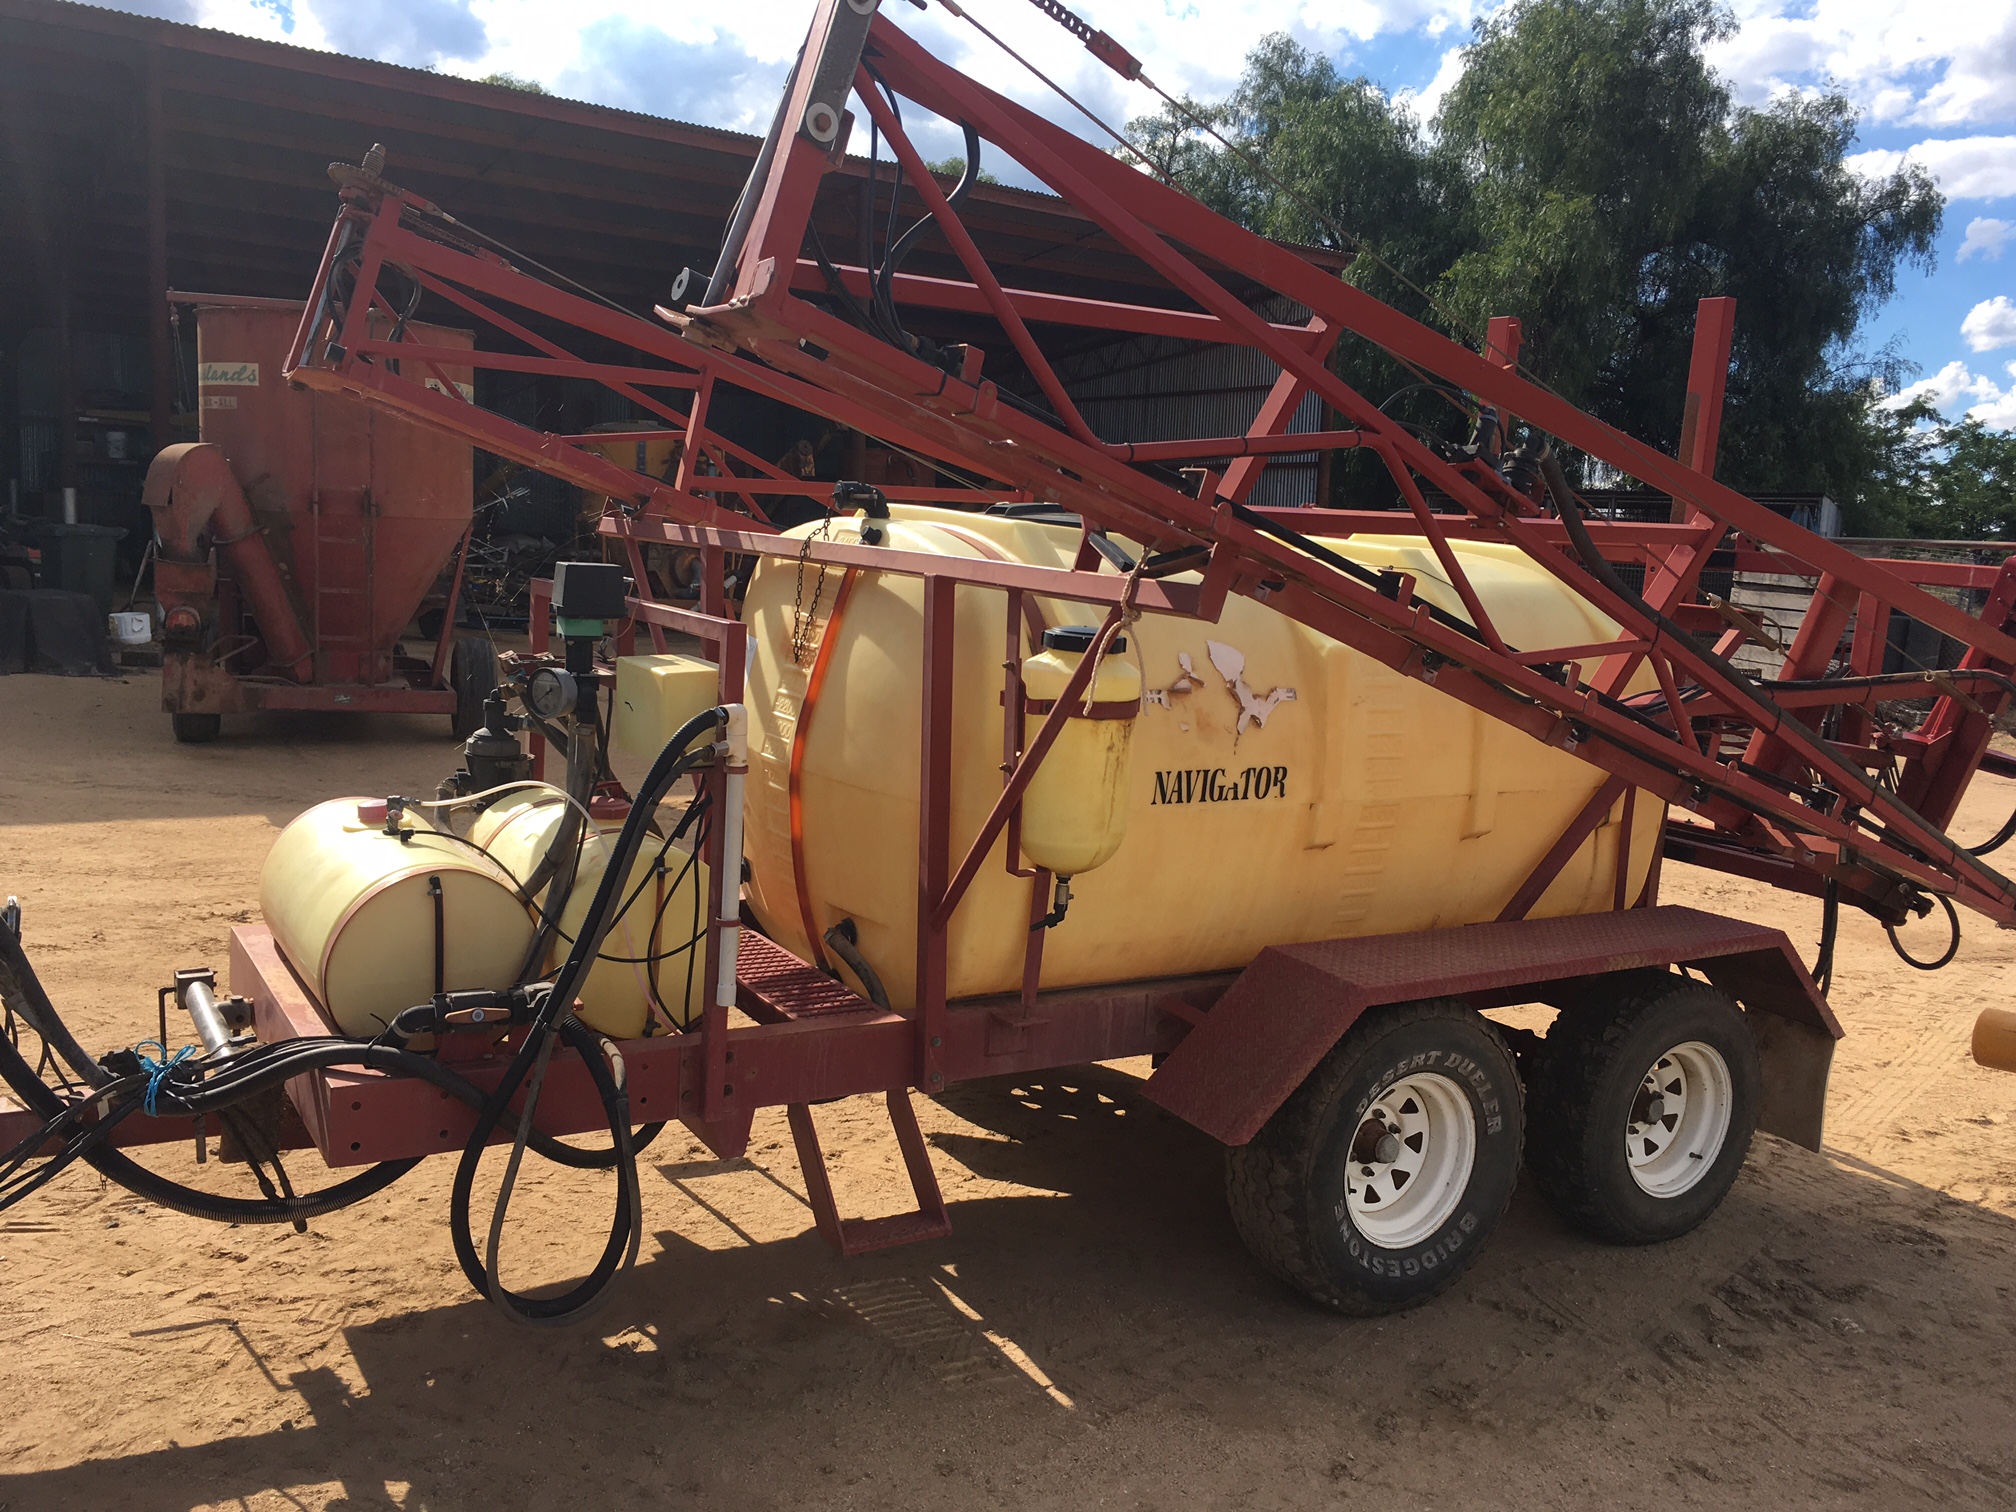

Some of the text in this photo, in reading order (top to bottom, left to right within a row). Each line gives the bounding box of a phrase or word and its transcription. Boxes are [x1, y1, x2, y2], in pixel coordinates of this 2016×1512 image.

[1150, 766, 1288, 805] NAVIGATOR
[1355, 1050, 1502, 1135] DESERT DUELER
[1334, 1199, 1478, 1277] BRIDGESTONE
